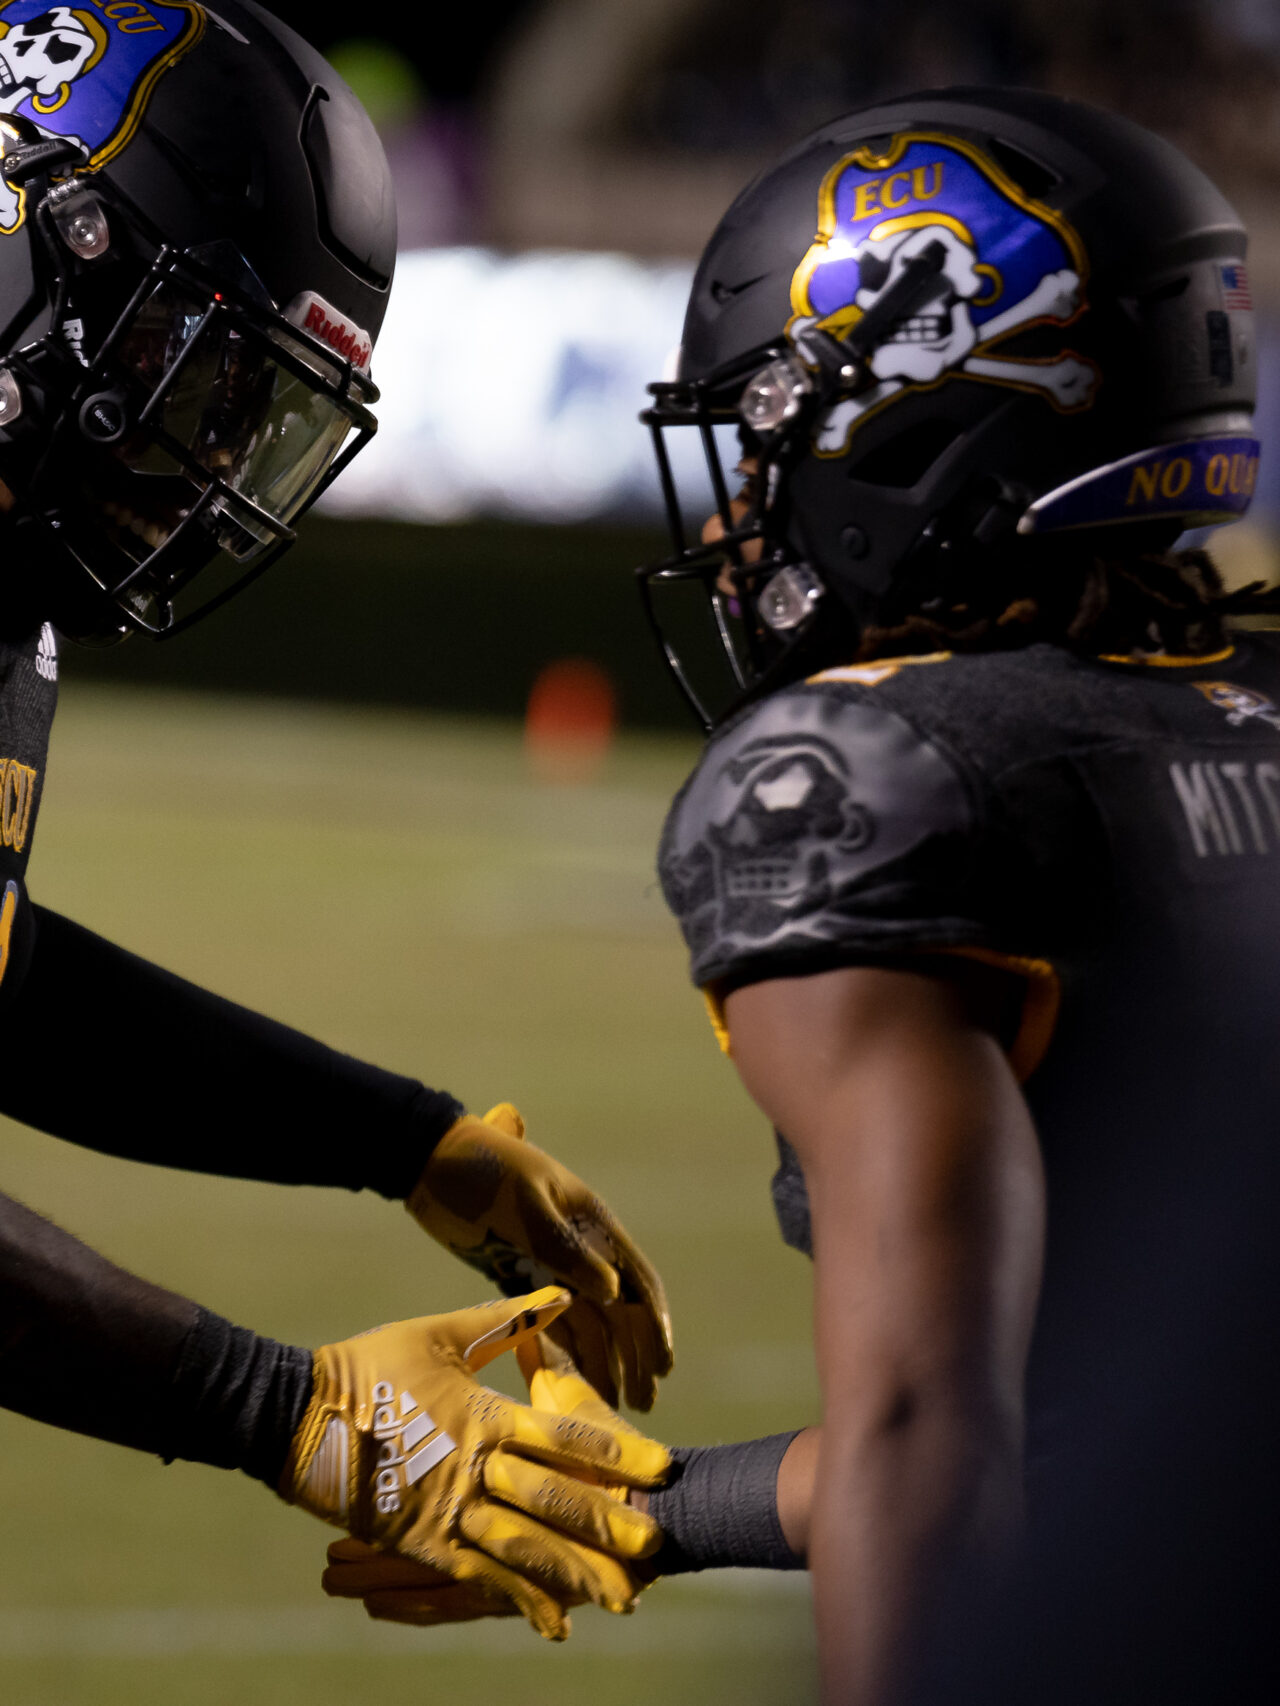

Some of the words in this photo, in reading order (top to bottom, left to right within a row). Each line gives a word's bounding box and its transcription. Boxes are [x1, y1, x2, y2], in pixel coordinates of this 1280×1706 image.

[89, 0, 167, 34] CU
[850, 162, 944, 222] ECU
[1125, 458, 1192, 505] NO
[372, 1380, 405, 1514] adidas
